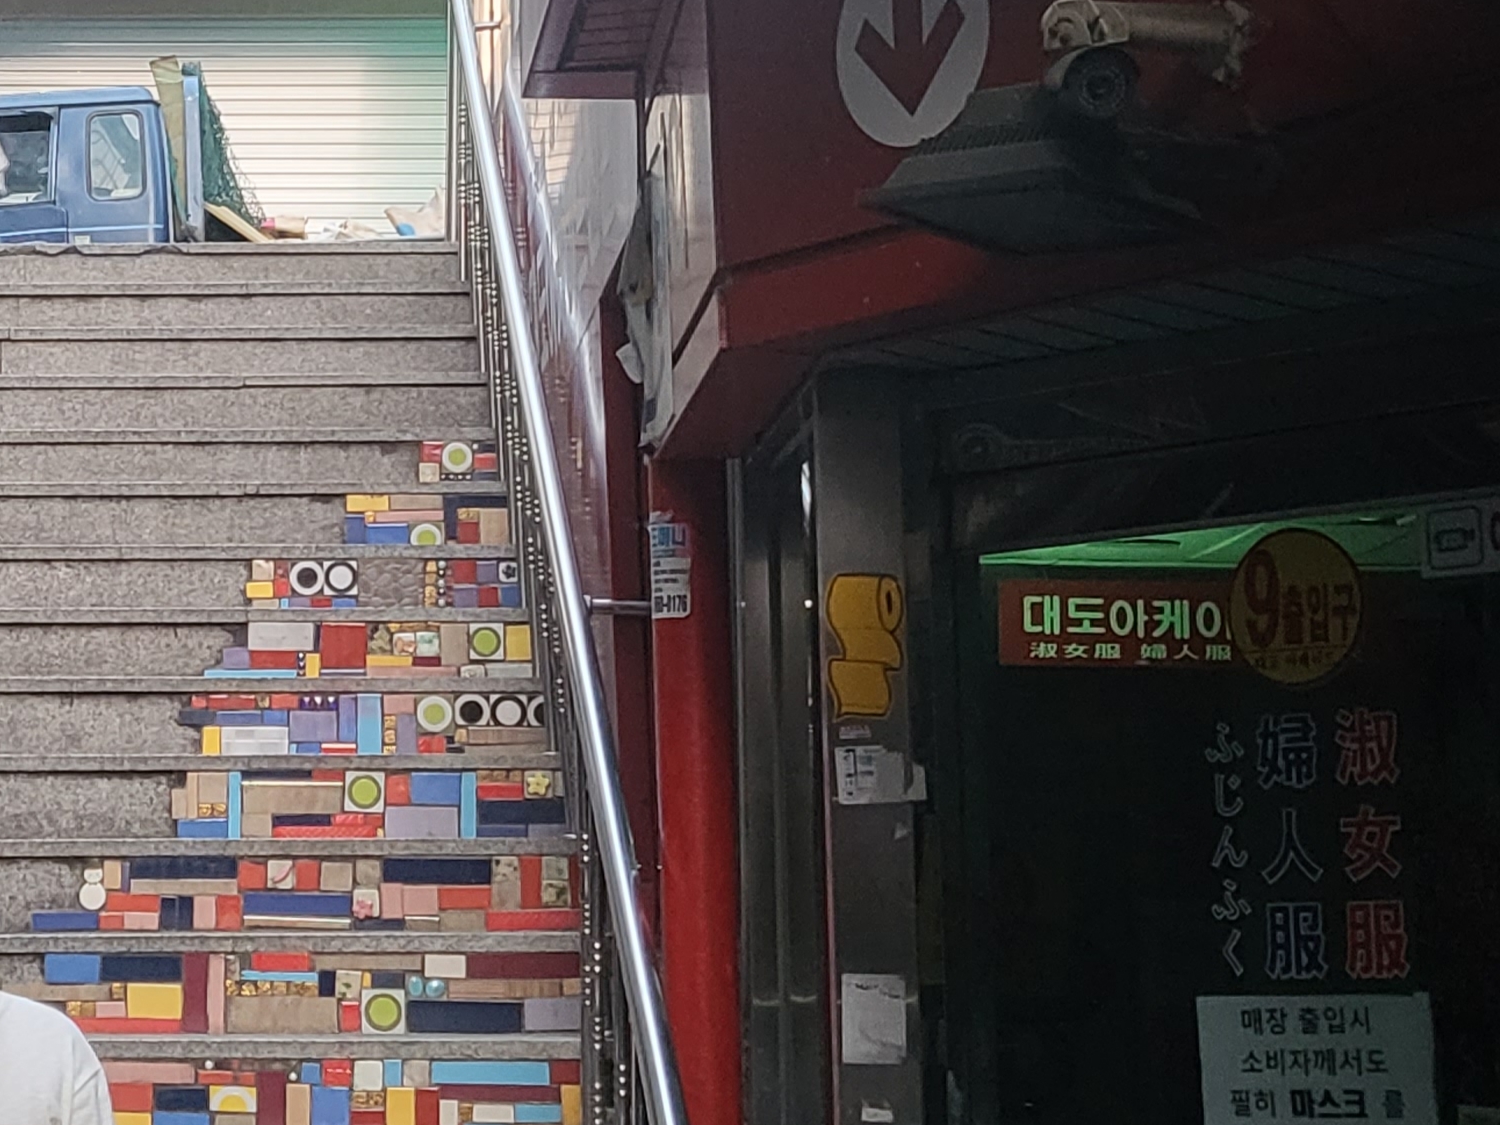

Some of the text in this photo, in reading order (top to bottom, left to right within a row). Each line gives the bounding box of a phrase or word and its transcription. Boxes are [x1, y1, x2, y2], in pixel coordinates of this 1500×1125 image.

[1244, 549, 1357, 648] 9 출입구
[1204, 721, 1253, 978] ふじんふく
[1255, 711, 1330, 980] 婦人服
[1333, 706, 1412, 979] 淑女服
[1240, 1006, 1372, 1036] 매장 출입시
[1240, 1048, 1389, 1077] 소비자께서도
[1230, 1089, 1277, 1119] 필히
[1290, 1087, 1369, 1119] 마스크
